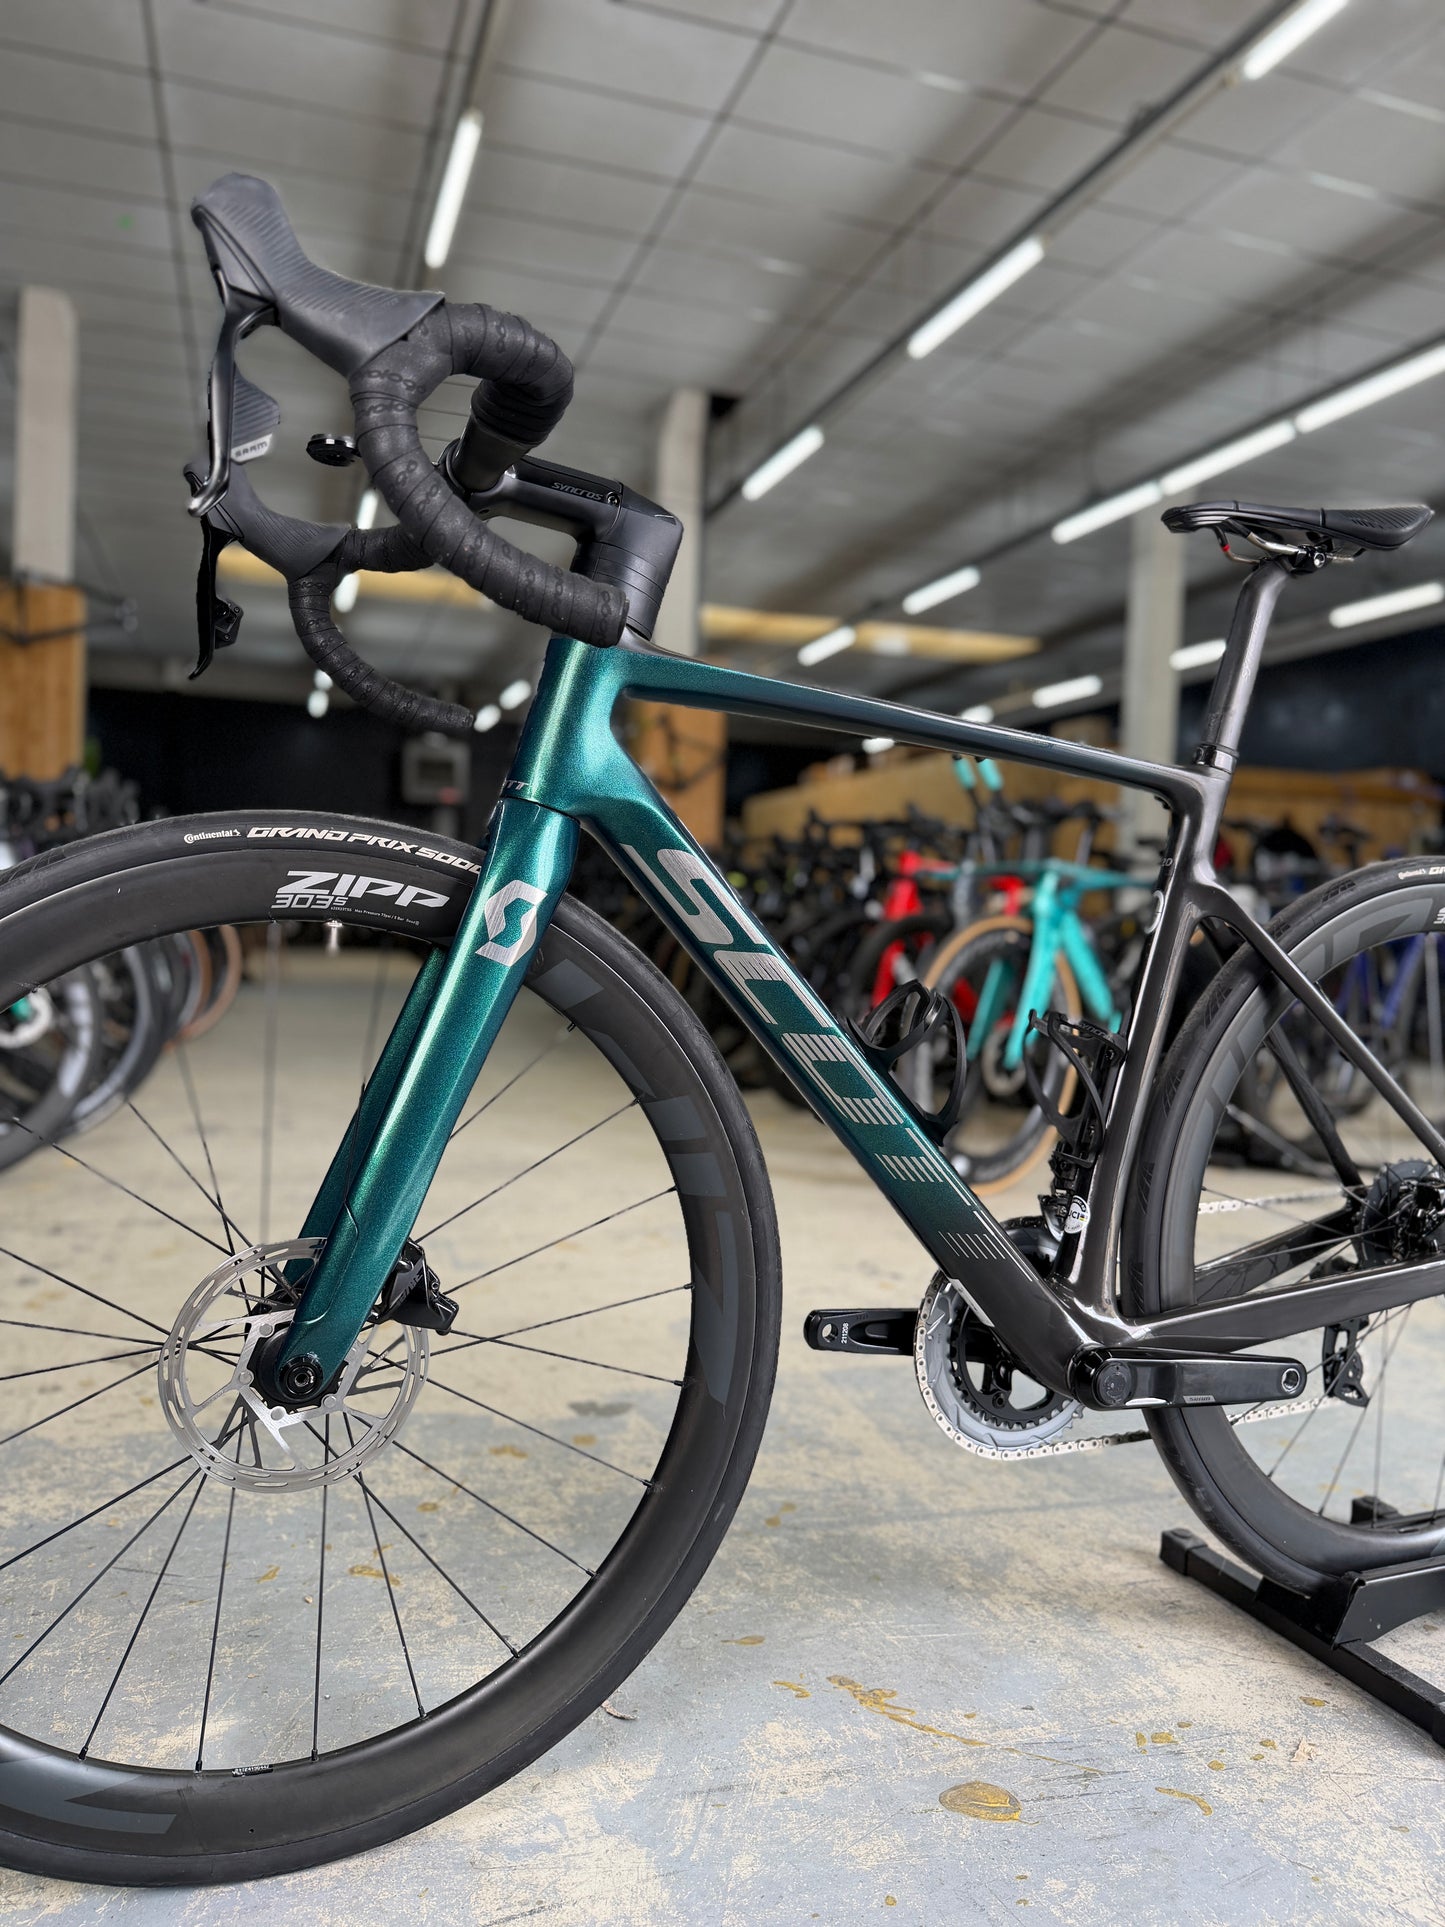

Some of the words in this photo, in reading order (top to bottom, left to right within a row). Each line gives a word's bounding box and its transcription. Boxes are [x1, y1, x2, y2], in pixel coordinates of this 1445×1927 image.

[184, 829, 233, 844] Continental
[246, 827, 350, 842] GRAND
[347, 832, 418, 854] PRIX
[276, 870, 450, 908] ZIPP
[620, 844, 1033, 1281] SCOTT
